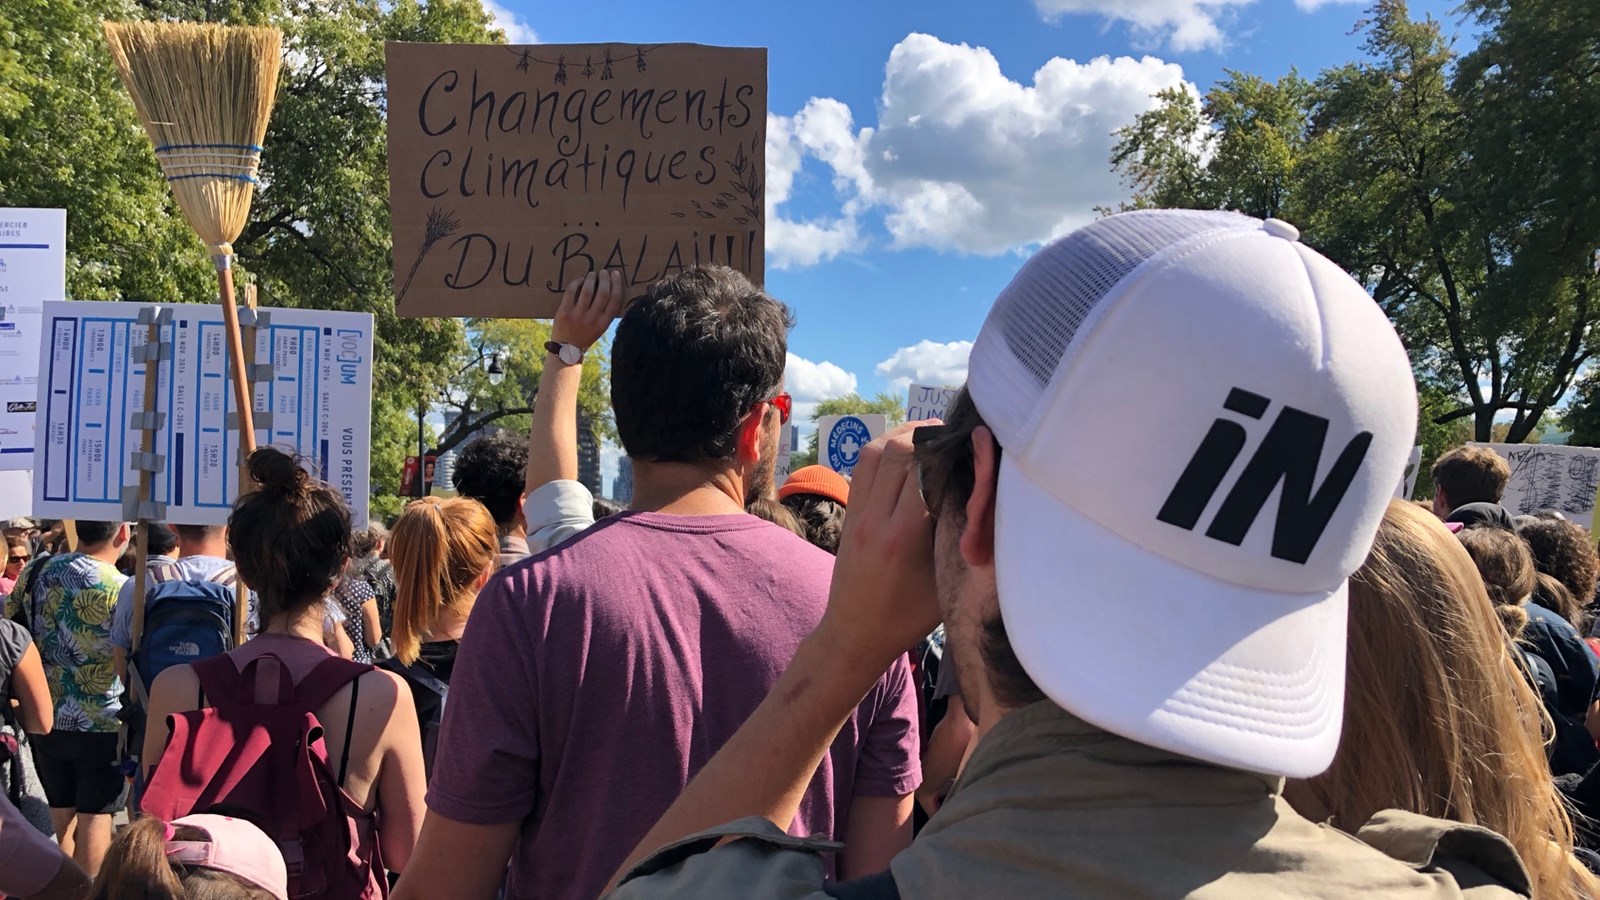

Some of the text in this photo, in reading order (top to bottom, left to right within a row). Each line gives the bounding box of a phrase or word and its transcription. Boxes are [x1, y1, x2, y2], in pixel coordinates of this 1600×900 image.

[418, 68, 754, 157] Changements
[419, 142, 717, 210] Climatiques
[444, 232, 534, 290] DU
[61, 327, 71, 351] 16H00
[96, 329, 105, 351] 13H00
[211, 332, 221, 356] 14H00
[289, 336, 298, 355] 9H00
[177, 384, 185, 405] SALLE
[322, 392, 330, 412] SALLE
[56, 421, 65, 445] 16H30
[342, 427, 353, 455] VOUS
[93, 439, 102, 463] 15H00
[209, 444, 218, 468] 15H30
[831, 453, 841, 468] DU
